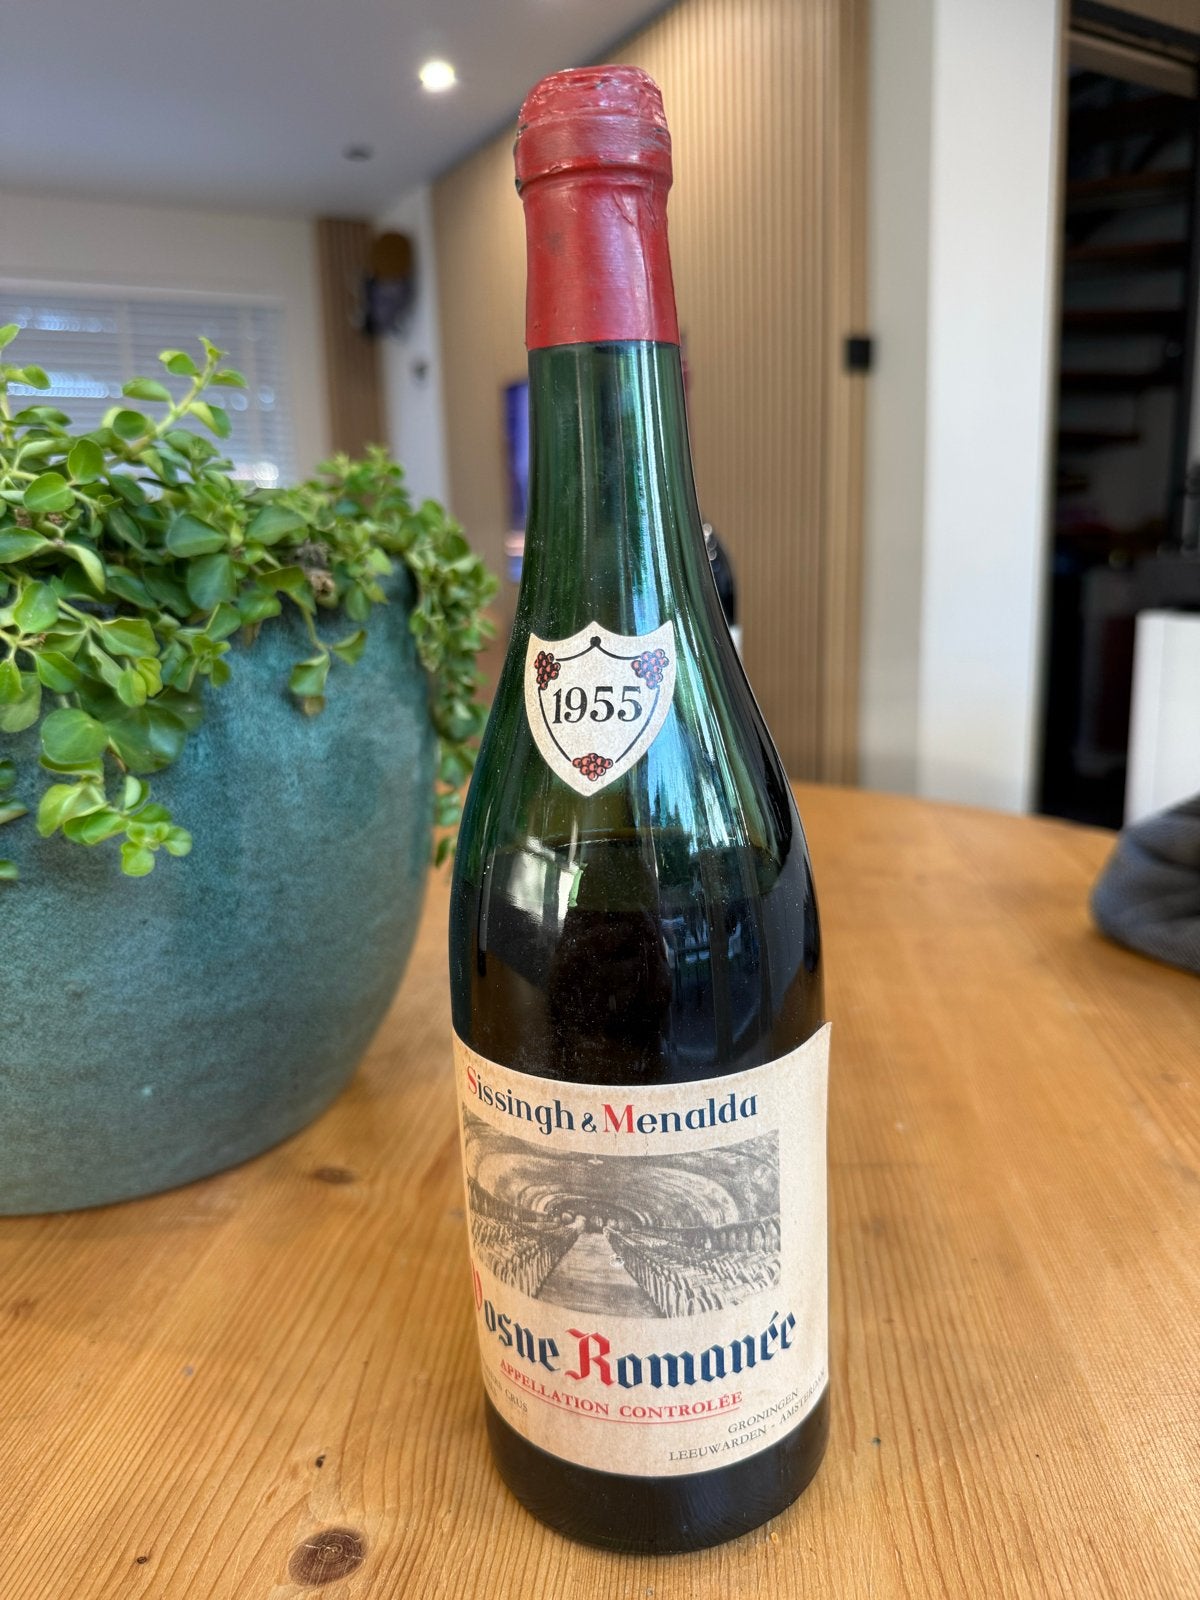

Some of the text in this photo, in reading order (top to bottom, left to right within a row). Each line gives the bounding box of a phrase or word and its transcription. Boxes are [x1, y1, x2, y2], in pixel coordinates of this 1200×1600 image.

[552, 685, 643, 724] 1955
[466, 1065, 759, 1135] Sissingh & Menalda
[565, 1310, 797, 1388] Romanée
[499, 1359, 610, 1416] APPELLATION
[619, 1391, 743, 1420] CONTROLÉE
[727, 1388, 800, 1434] GRONINGEN
[669, 1424, 767, 1461] LEEUWARDEN
